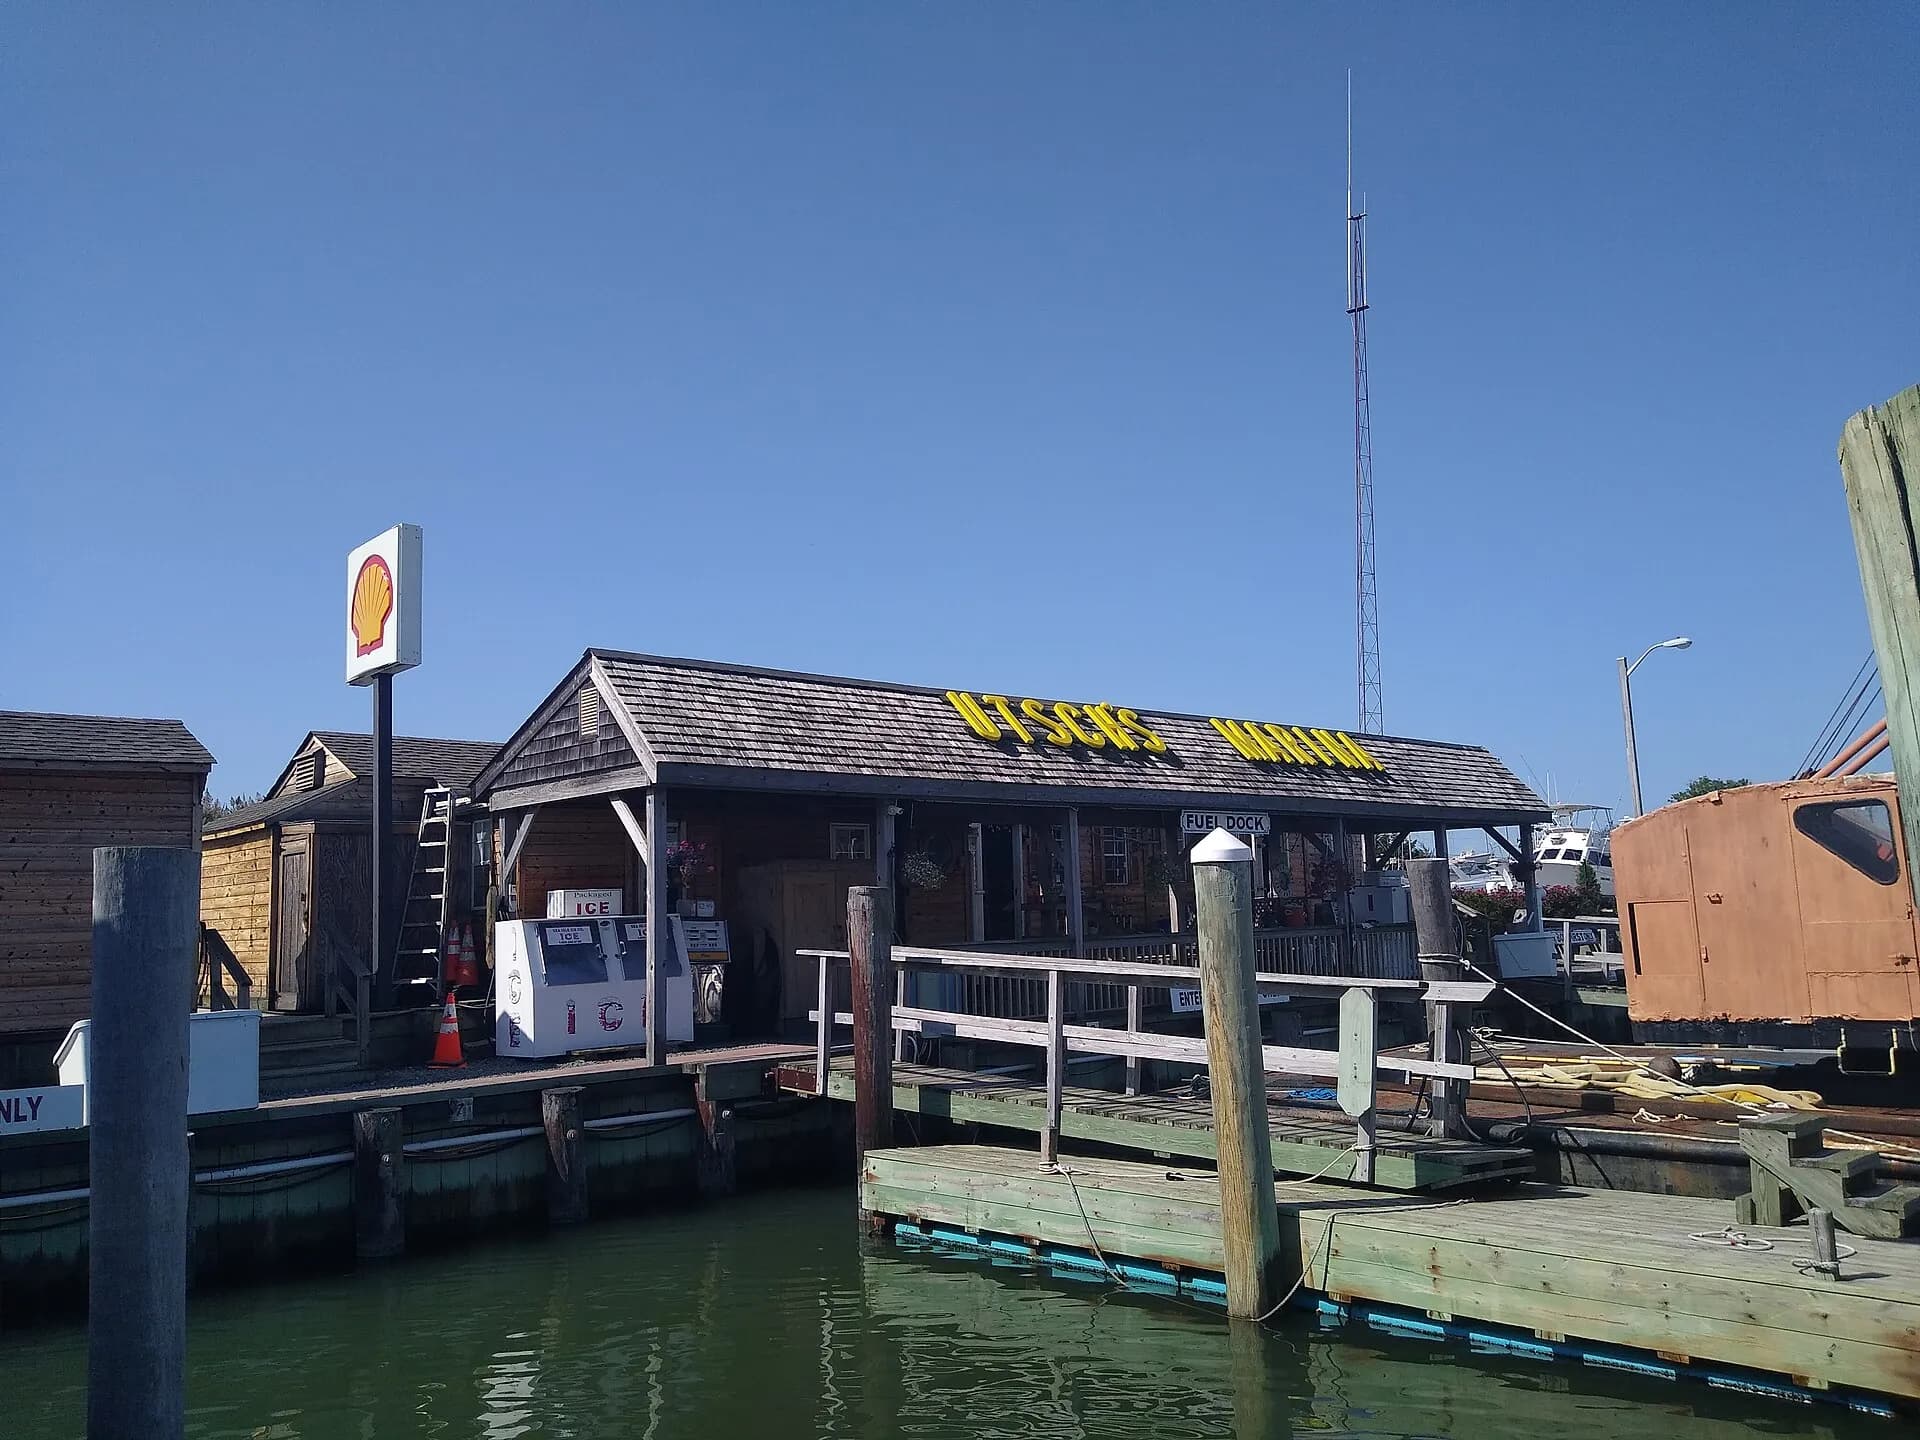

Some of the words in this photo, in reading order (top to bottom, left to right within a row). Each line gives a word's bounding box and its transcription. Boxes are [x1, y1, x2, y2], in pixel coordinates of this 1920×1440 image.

[1208, 717, 1386, 772] MARINA
[1226, 815, 1265, 831] DOCK
[576, 901, 609, 915] ICE
[560, 932, 580, 940] ICE
